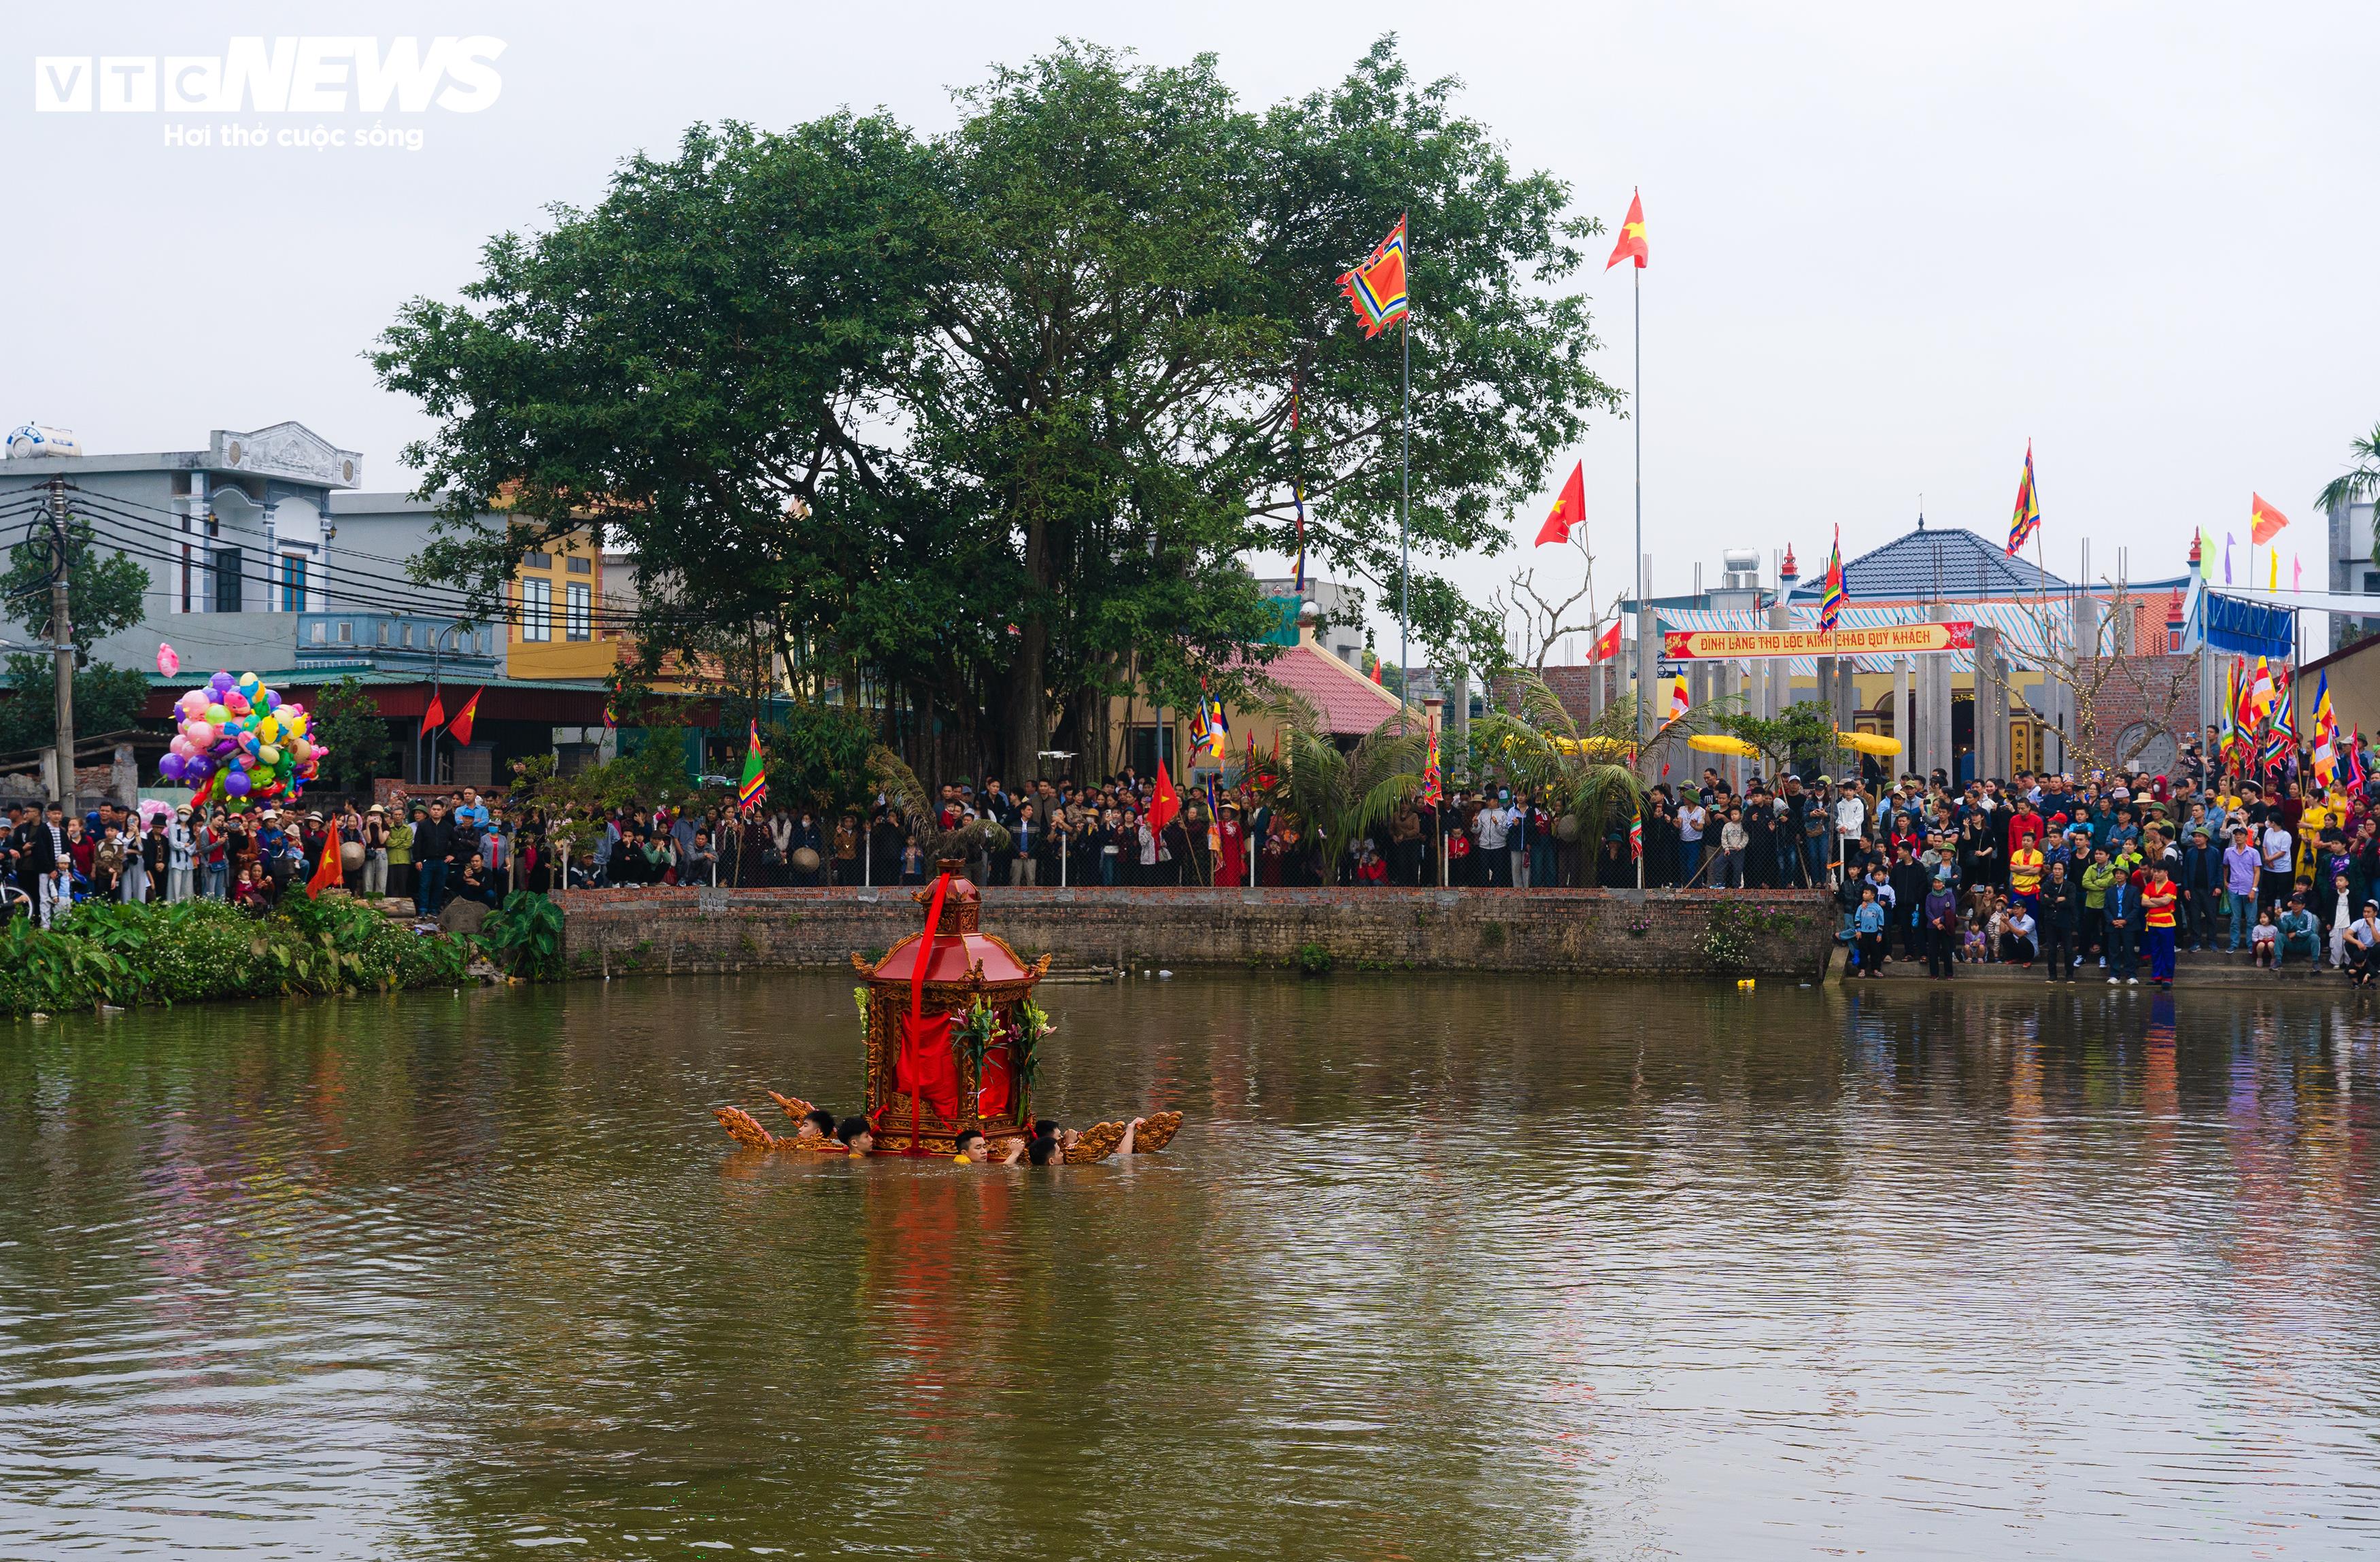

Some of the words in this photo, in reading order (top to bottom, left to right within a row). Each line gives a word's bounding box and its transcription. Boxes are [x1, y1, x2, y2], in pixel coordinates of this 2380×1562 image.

[1701, 635, 1725, 651] ĐÌNH
[1729, 634, 1755, 650] LÀNG
[1758, 636, 1779, 651] THỌ
[1784, 633, 1803, 651] LỘC
[1837, 630, 1865, 646] CHÀO
[1869, 630, 1889, 647] QUÝ
[1892, 628, 1931, 645] KHÁCH
